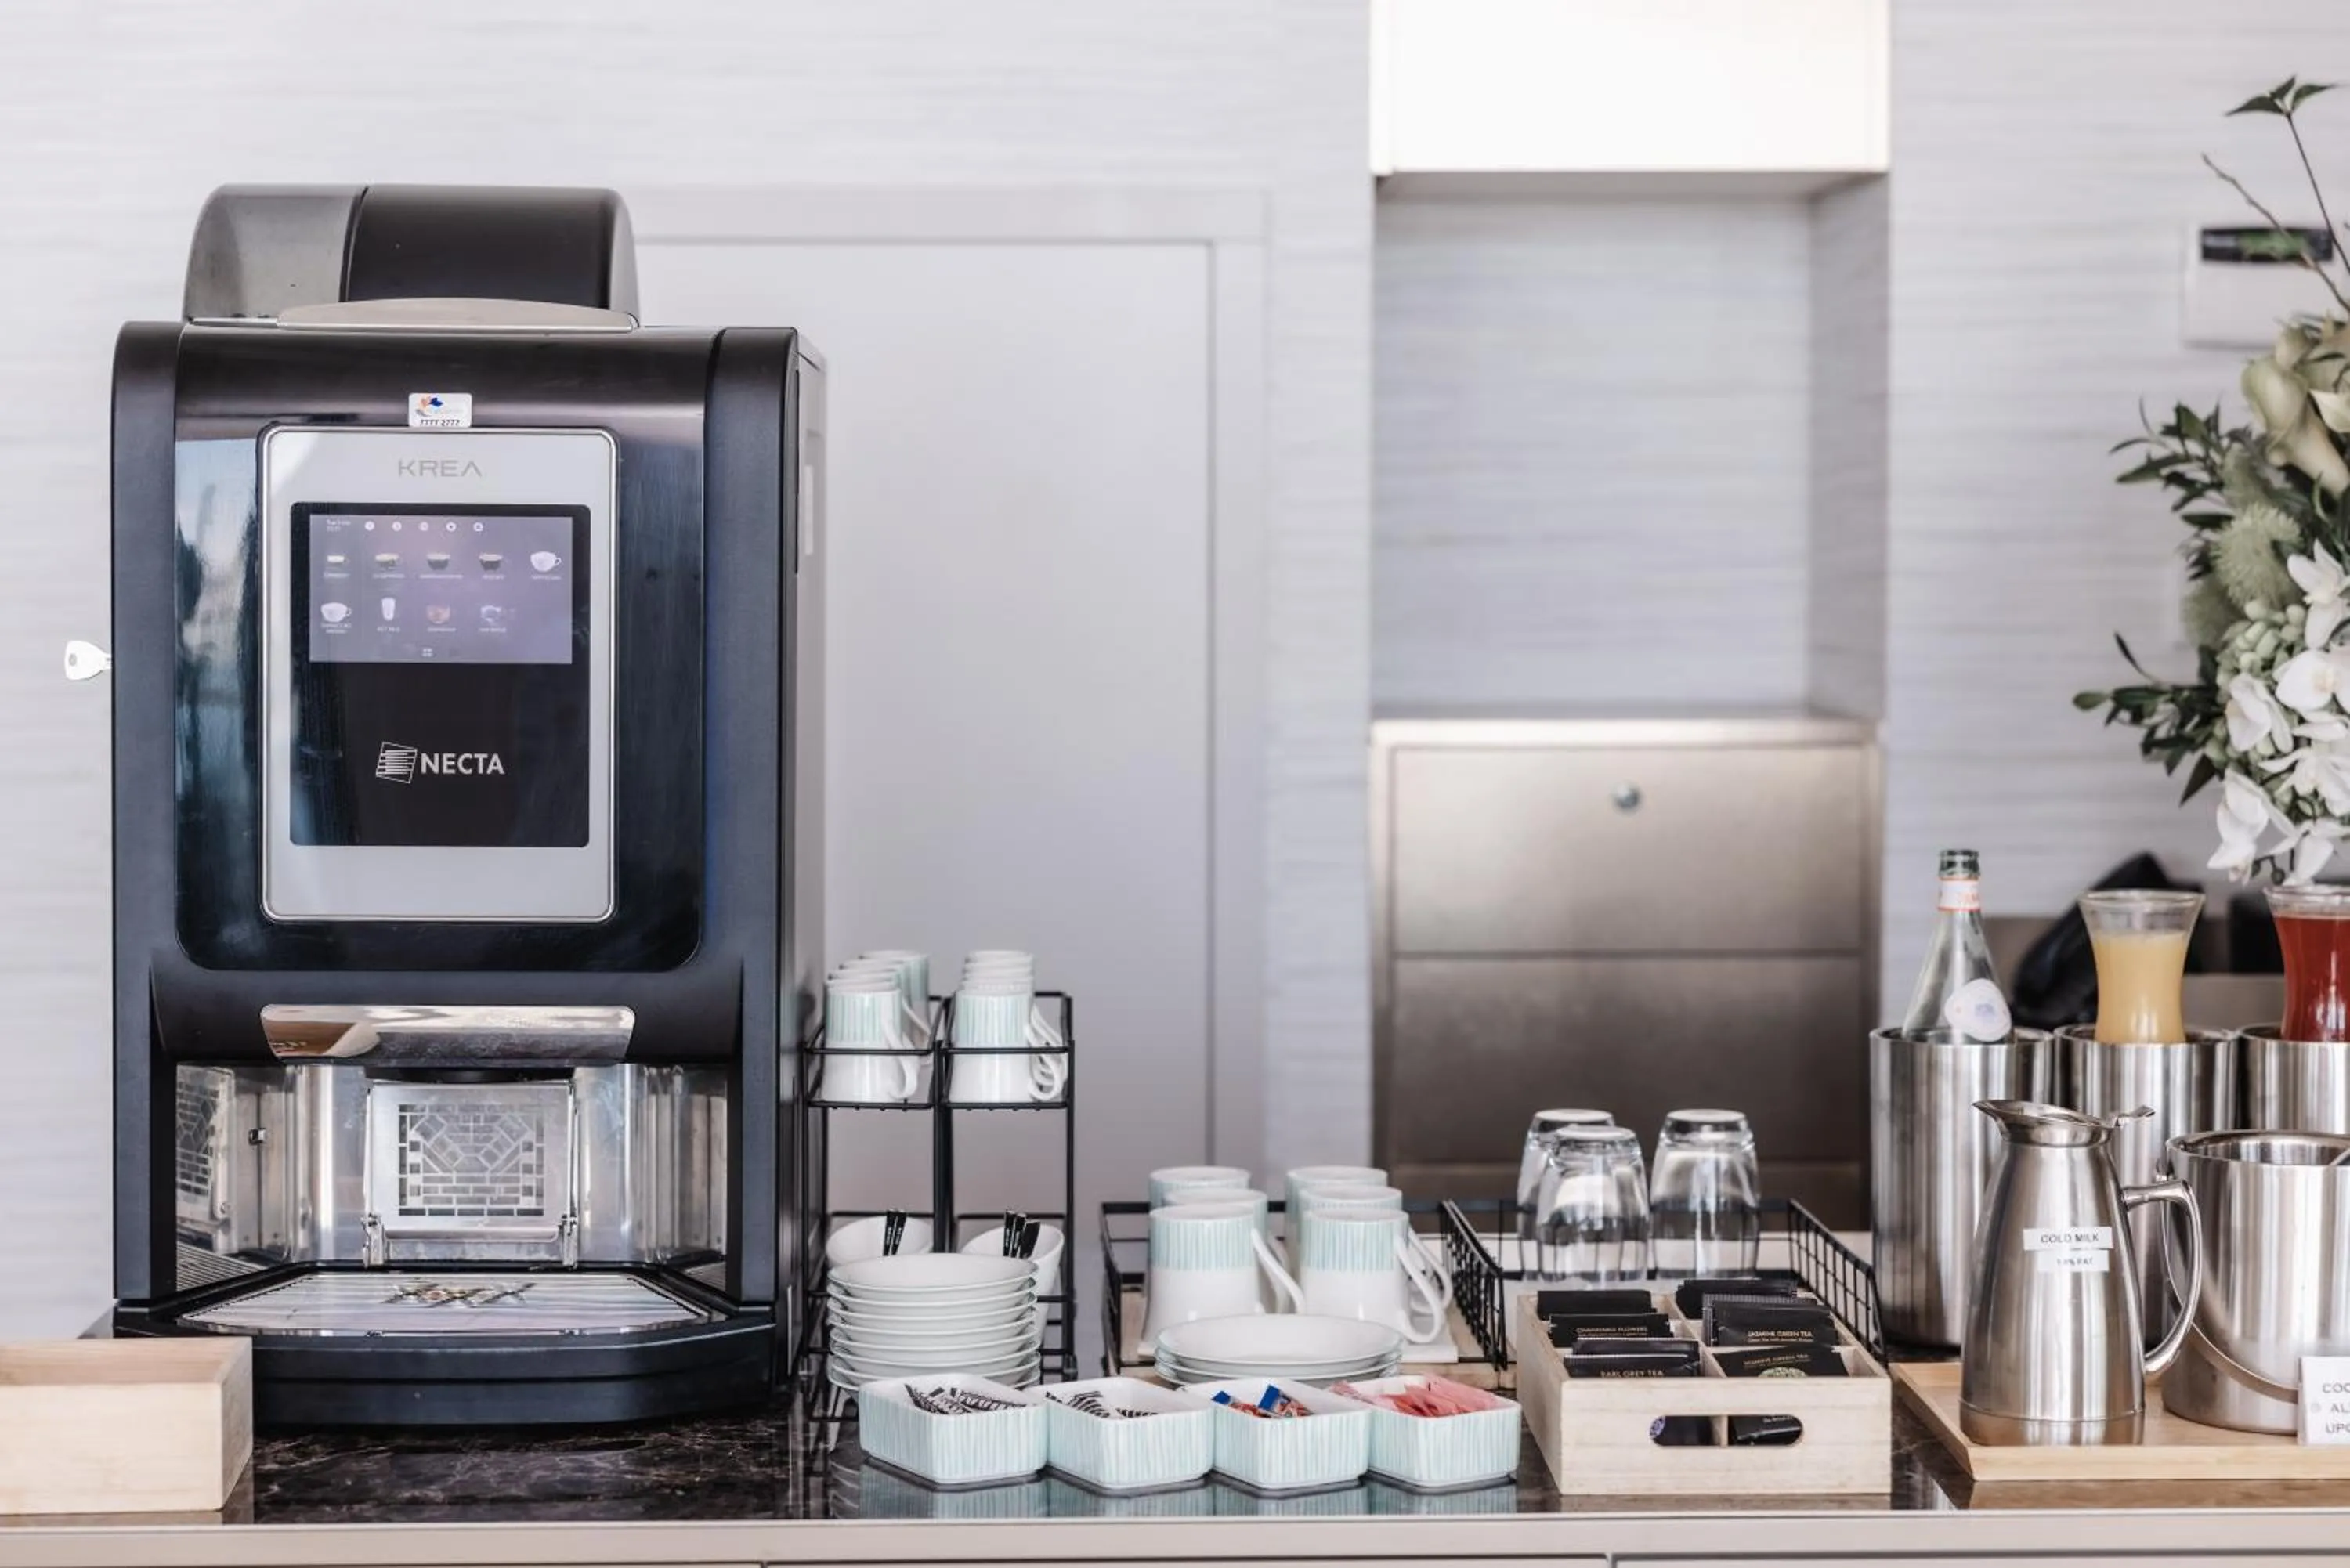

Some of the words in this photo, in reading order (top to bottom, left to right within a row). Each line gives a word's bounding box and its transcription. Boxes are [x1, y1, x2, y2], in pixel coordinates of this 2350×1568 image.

[398, 459, 483, 477] KREA
[421, 753, 505, 775] NECTA
[2041, 1234, 2072, 1243] COLD
[2074, 1233, 2099, 1242] MILK
[1647, 1368, 1665, 1378] TEA
